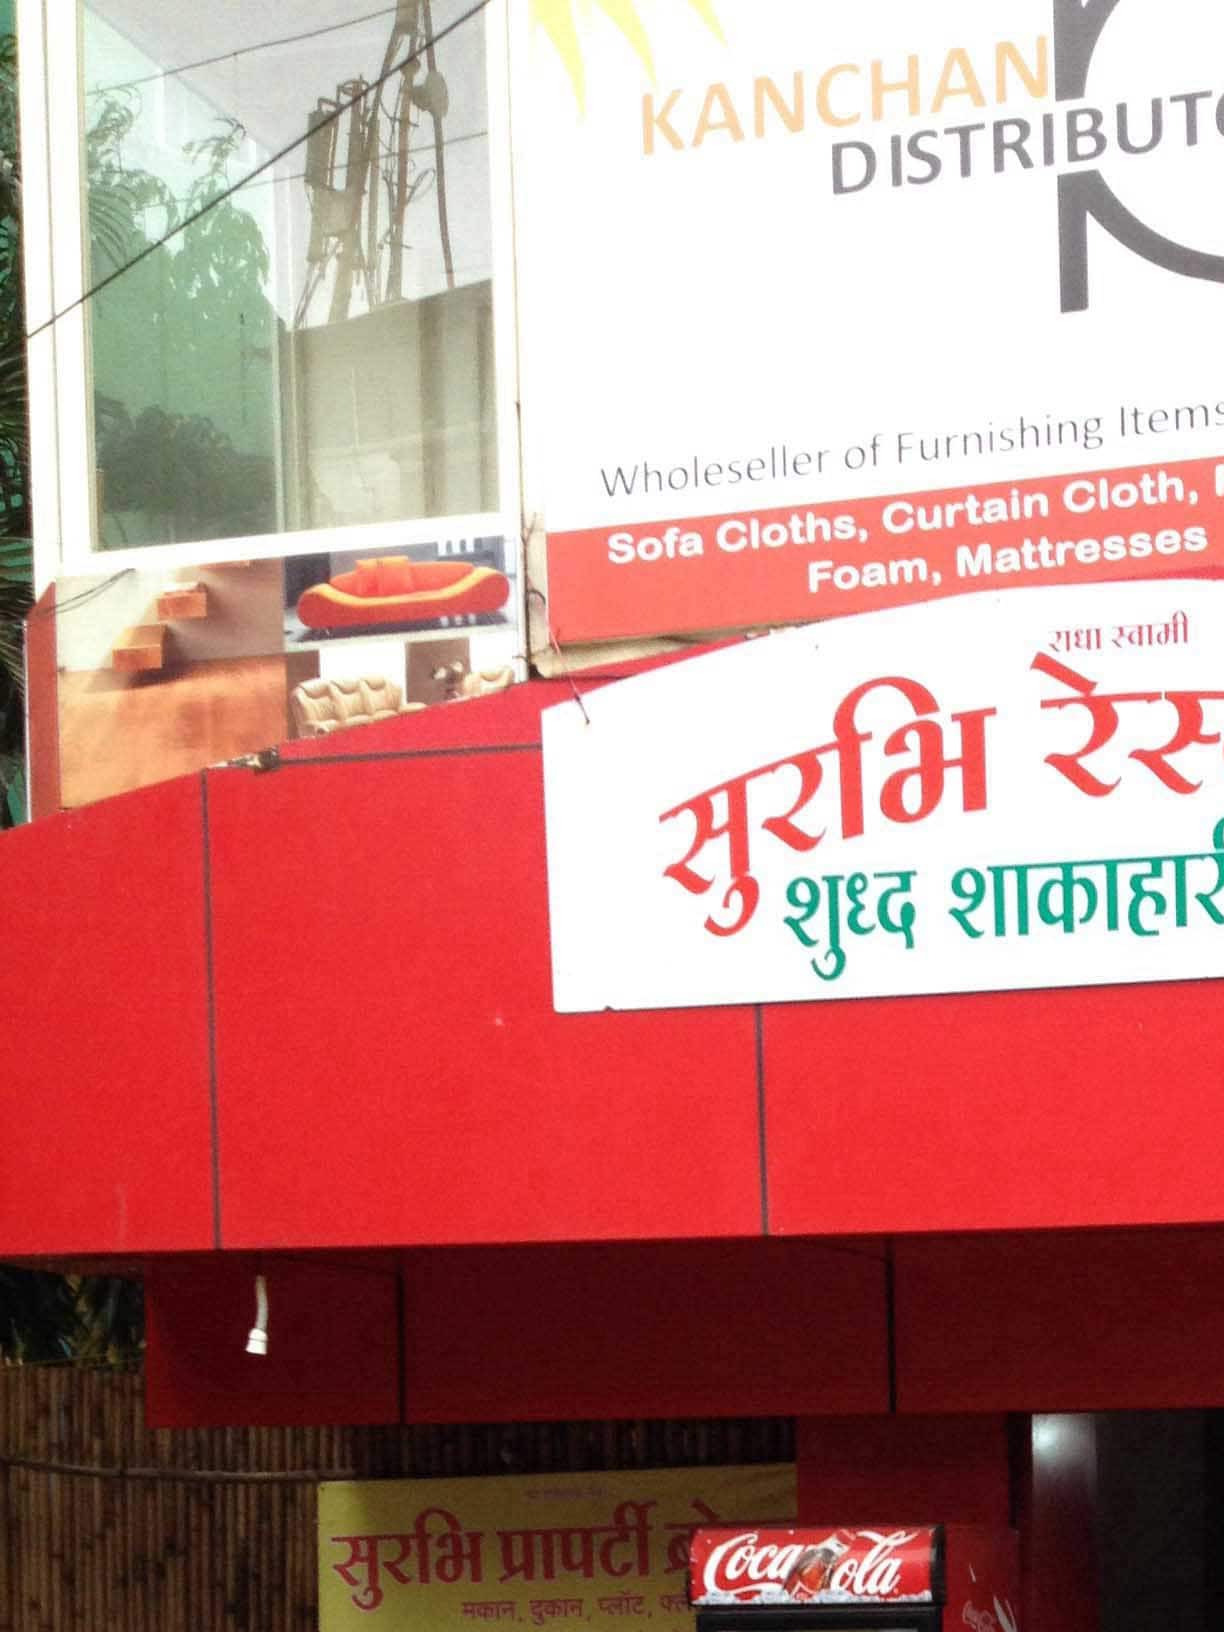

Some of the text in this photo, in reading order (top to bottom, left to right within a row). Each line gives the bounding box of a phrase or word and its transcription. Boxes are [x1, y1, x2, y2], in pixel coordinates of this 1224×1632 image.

[640, 35, 1050, 156] KANCHAN
[600, 443, 832, 498] Wholeseller
[844, 434, 883, 471] of
[896, 411, 1104, 465] Furnishing
[607, 527, 704, 565] Sofa
[715, 504, 869, 553] Cloths,
[881, 488, 1050, 534] Curtain
[1062, 471, 1199, 514] Cloth,
[807, 523, 1209, 593] Foam, Mattresses
[1048, 609, 1189, 653] राधा स्वामी
[659, 676, 998, 937] सुरभि
[331, 1506, 486, 1612] सुरभि
[702, 1532, 919, 1596] Cocaola
